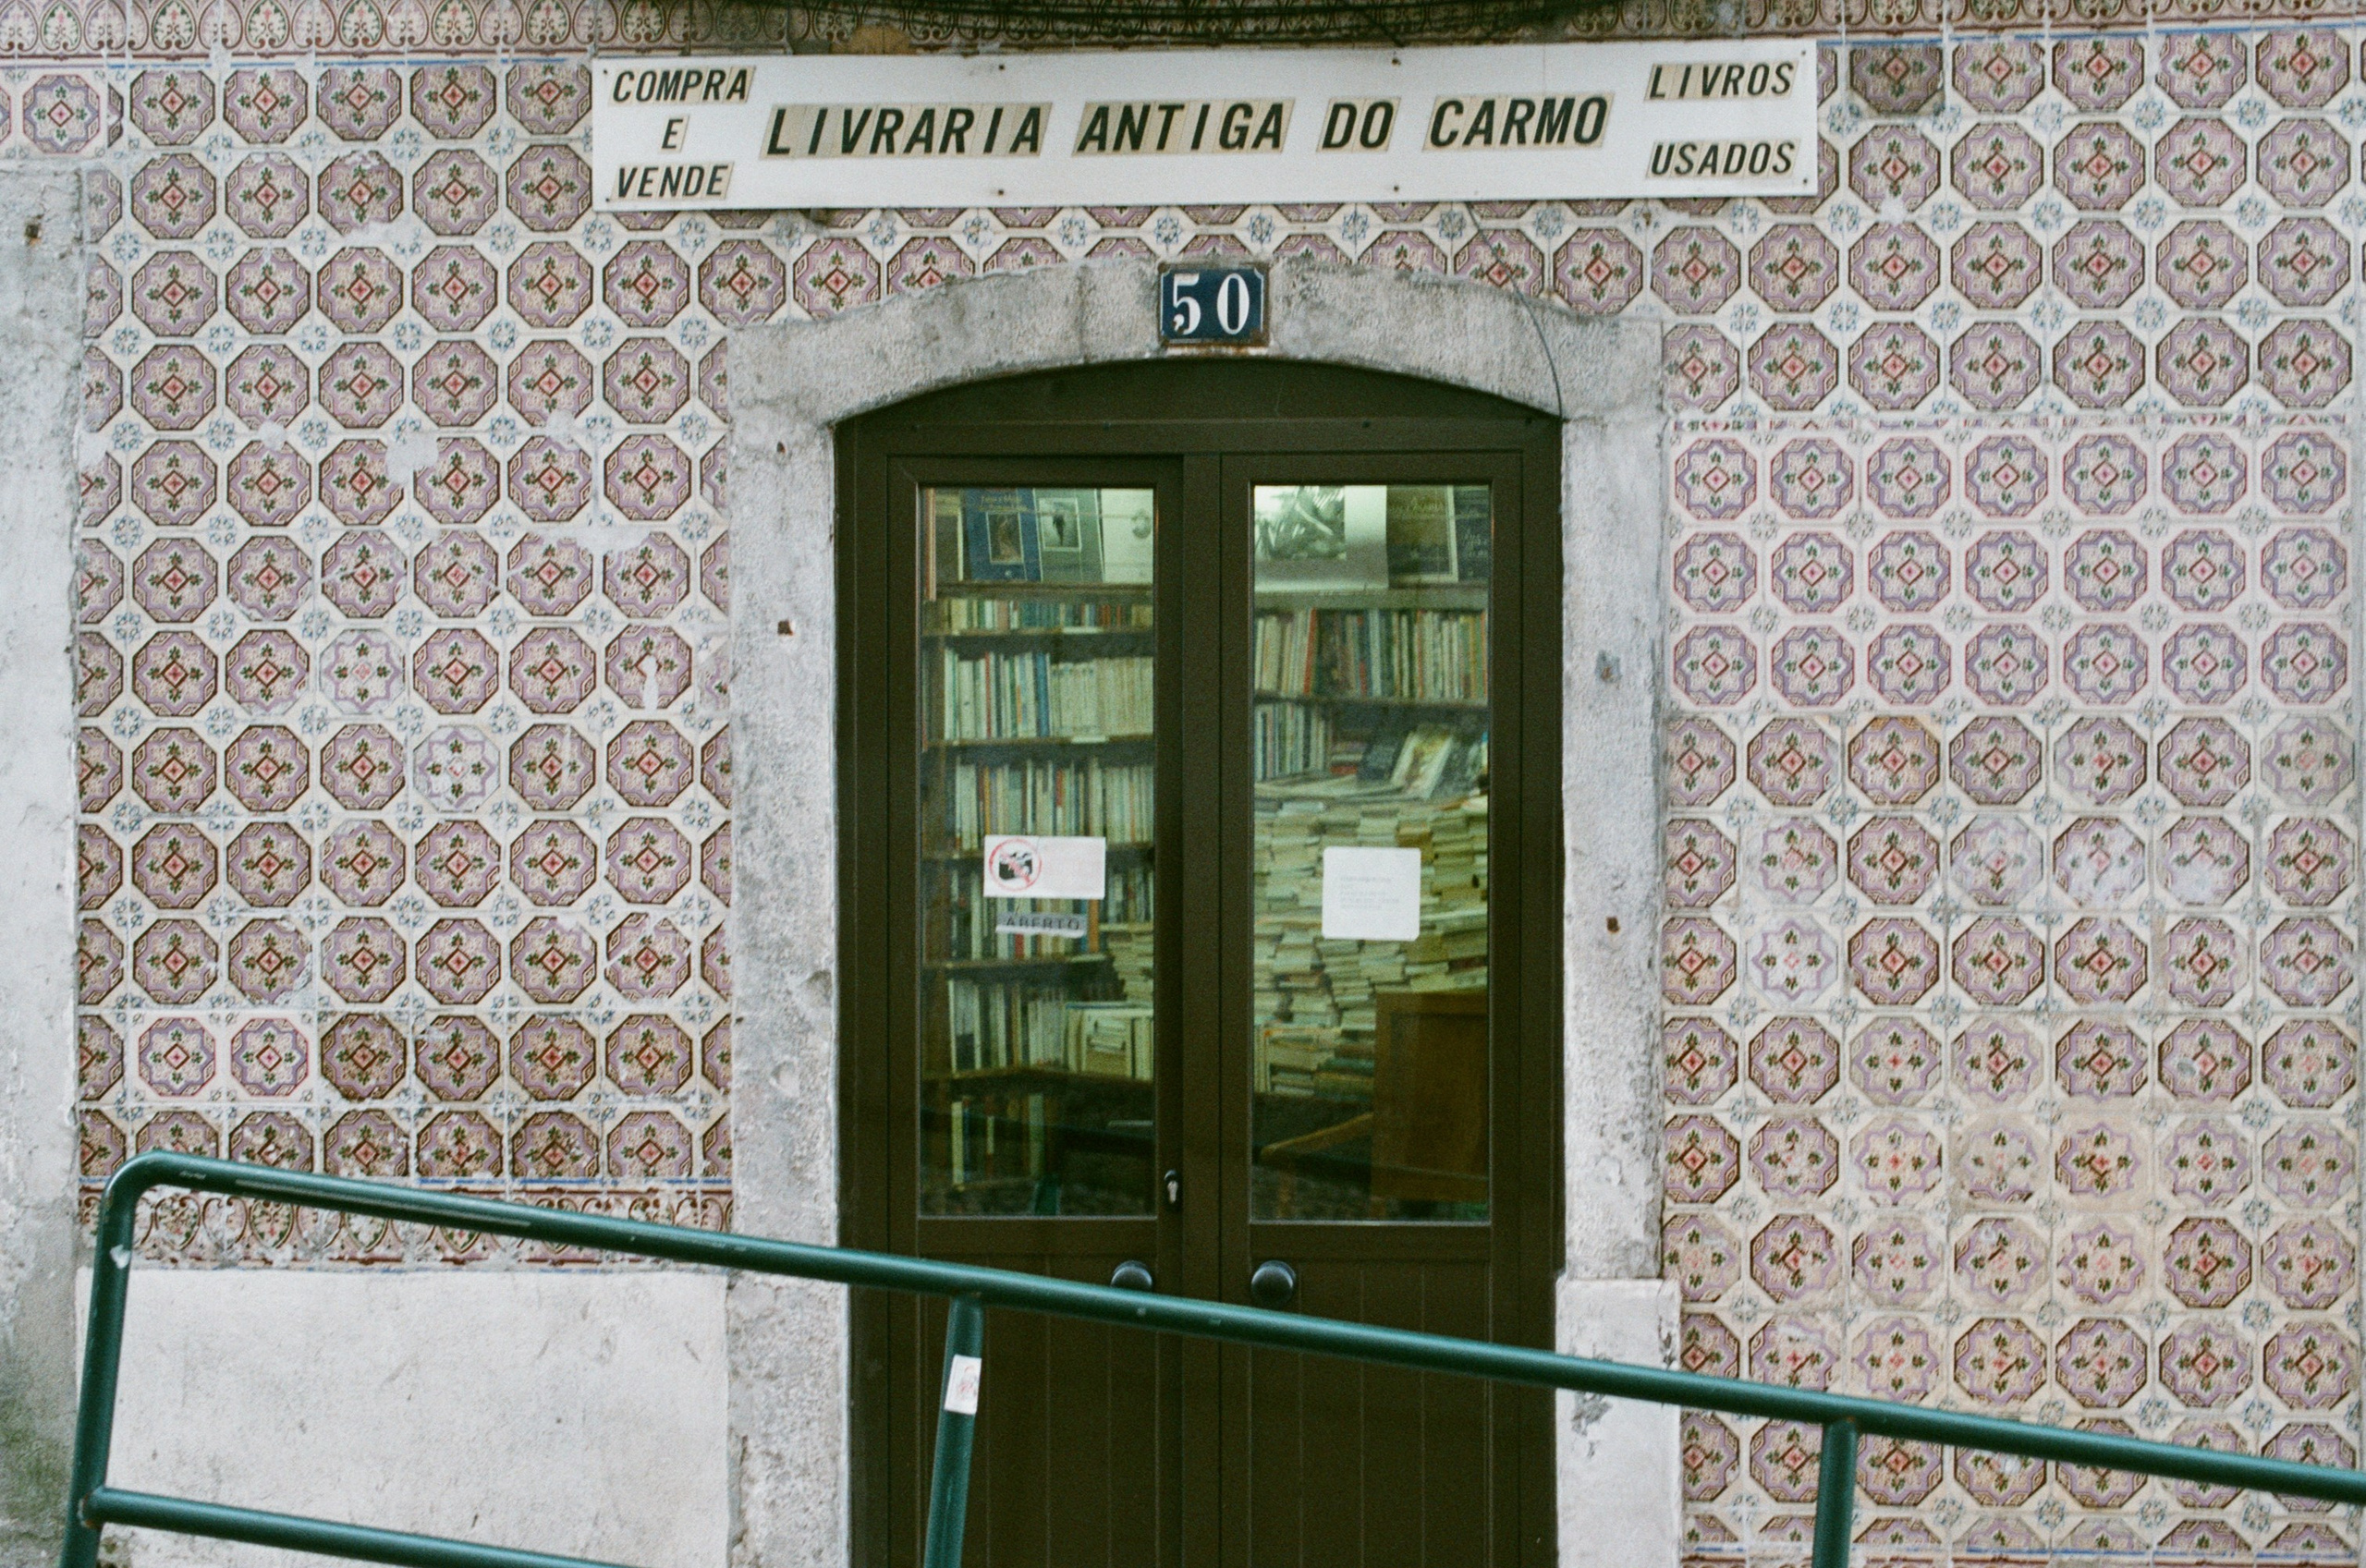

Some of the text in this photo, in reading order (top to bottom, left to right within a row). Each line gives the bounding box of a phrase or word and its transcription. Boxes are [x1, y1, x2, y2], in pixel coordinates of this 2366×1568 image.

[614, 69, 747, 102] COMPRA
[1651, 64, 1792, 98] LIVROS
[663, 119, 682, 148] E
[768, 97, 1607, 154] LIVRARIA ANTIGA DO CARMO
[1653, 143, 1790, 175] USADOS
[619, 166, 727, 197] VENDE
[1173, 273, 1250, 334] 50
[1006, 915, 1080, 930] ABERTO
